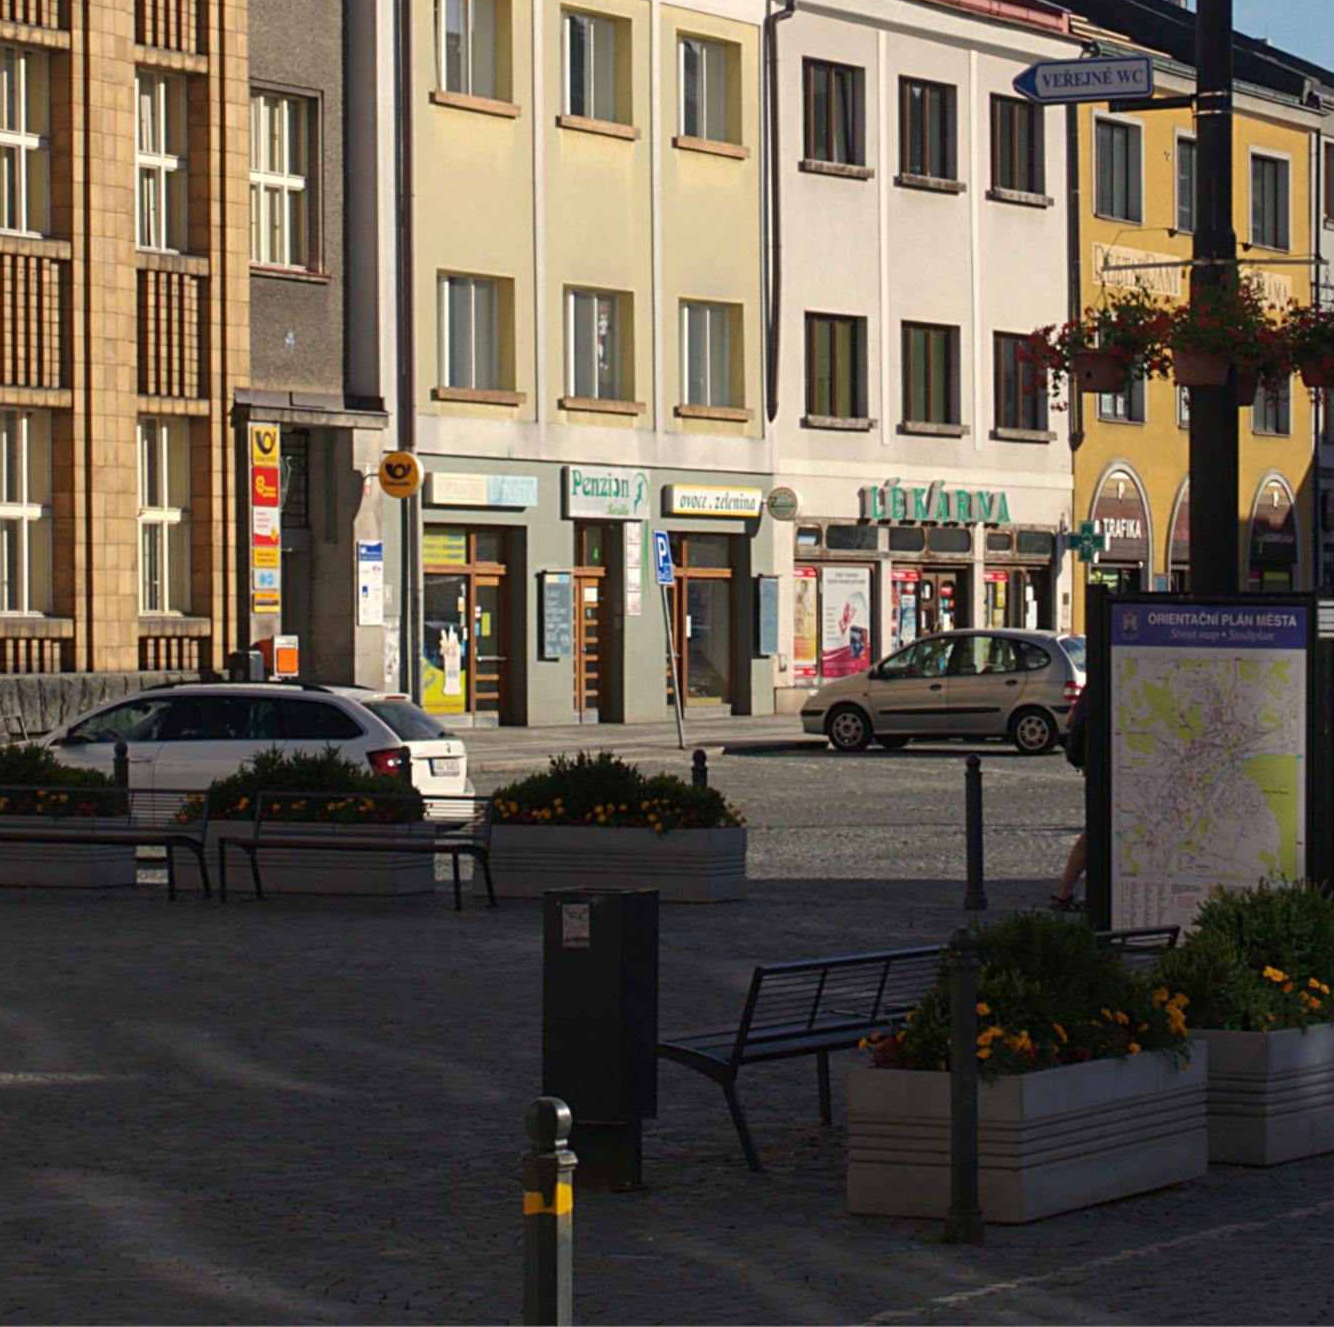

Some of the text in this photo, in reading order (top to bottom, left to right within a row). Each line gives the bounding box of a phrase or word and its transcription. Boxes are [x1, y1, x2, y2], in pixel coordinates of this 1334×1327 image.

[1042, 67, 1144, 88] VEŘEJNÉ WC
[571, 468, 630, 498] Penzion
[679, 494, 707, 510] ovoce
[714, 491, 756, 511] zelenina
[870, 477, 1011, 523] LÉKÁRNA
[1102, 518, 1142, 539] TRAFIKA
[1147, 610, 1298, 627] ORIENTAČNÍ PLÁN MĚSTA
[1170, 628, 1275, 643] Street map Stadtplan
